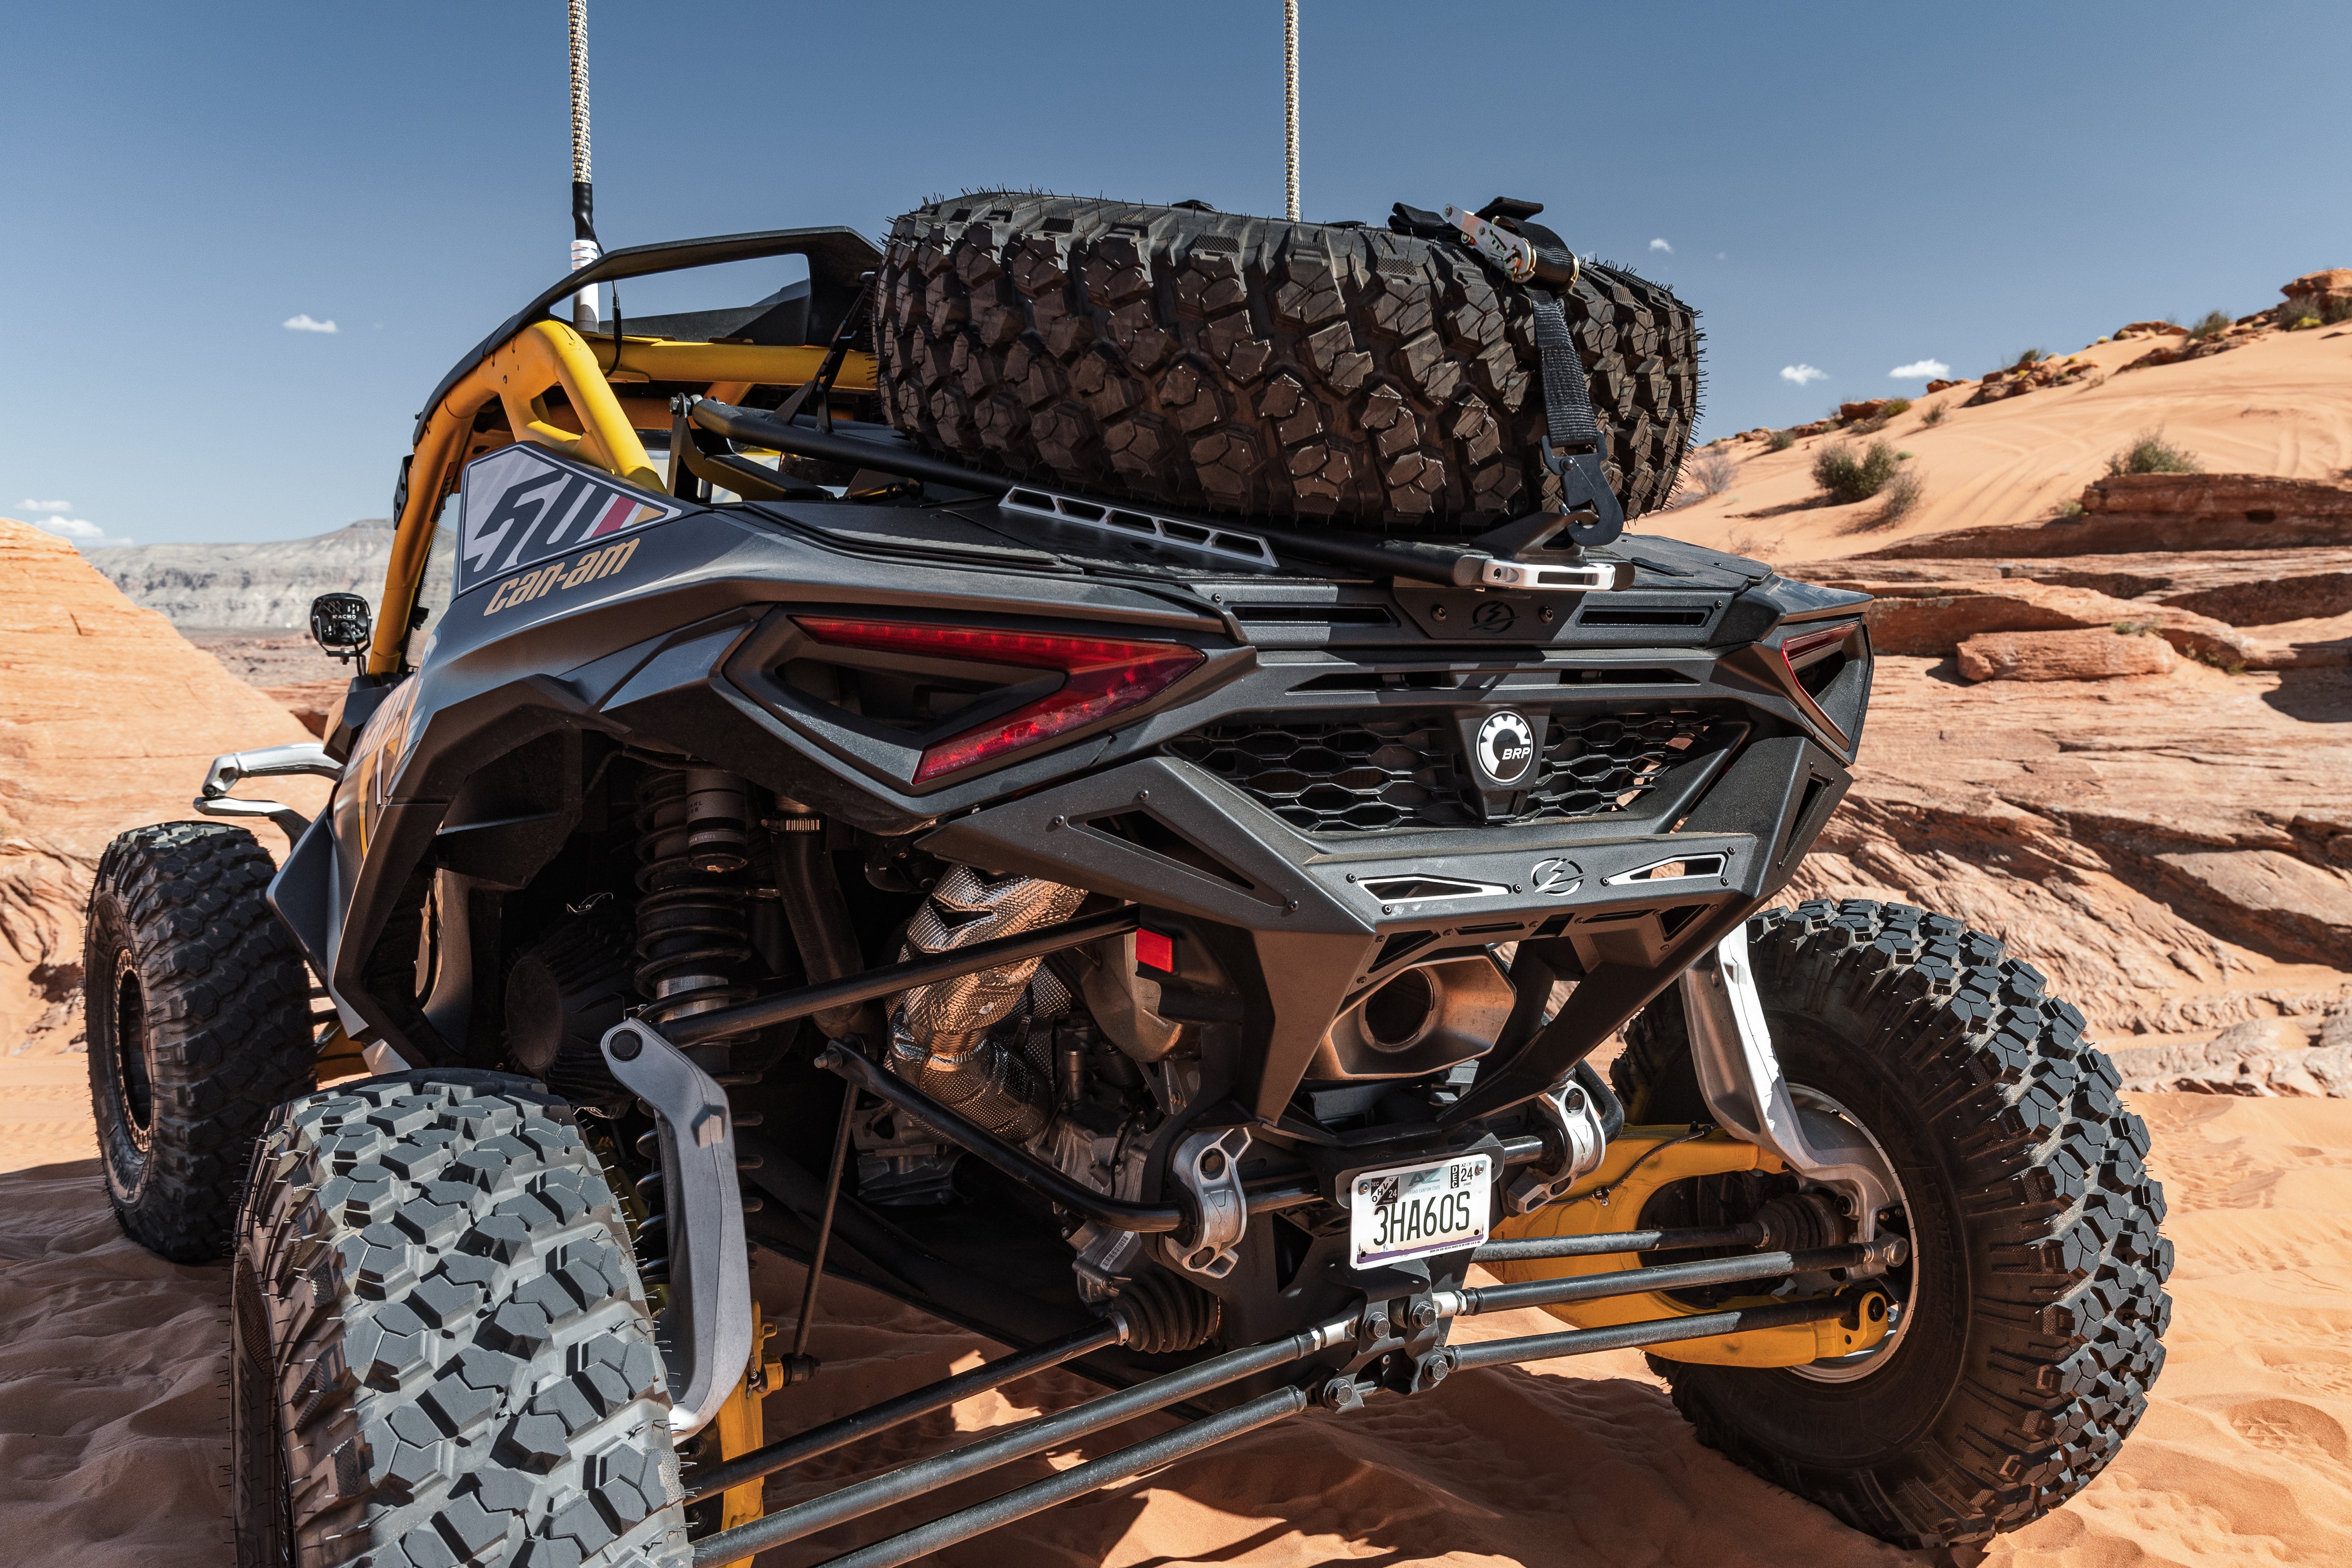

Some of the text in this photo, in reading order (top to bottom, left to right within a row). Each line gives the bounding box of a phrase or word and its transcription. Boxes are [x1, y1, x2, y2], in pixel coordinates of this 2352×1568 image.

[1502, 747, 1531, 760] BRP
[1408, 1169, 1441, 1187] AZ
[1461, 1167, 1473, 1182] 24
[1388, 1189, 1397, 1198] 24
